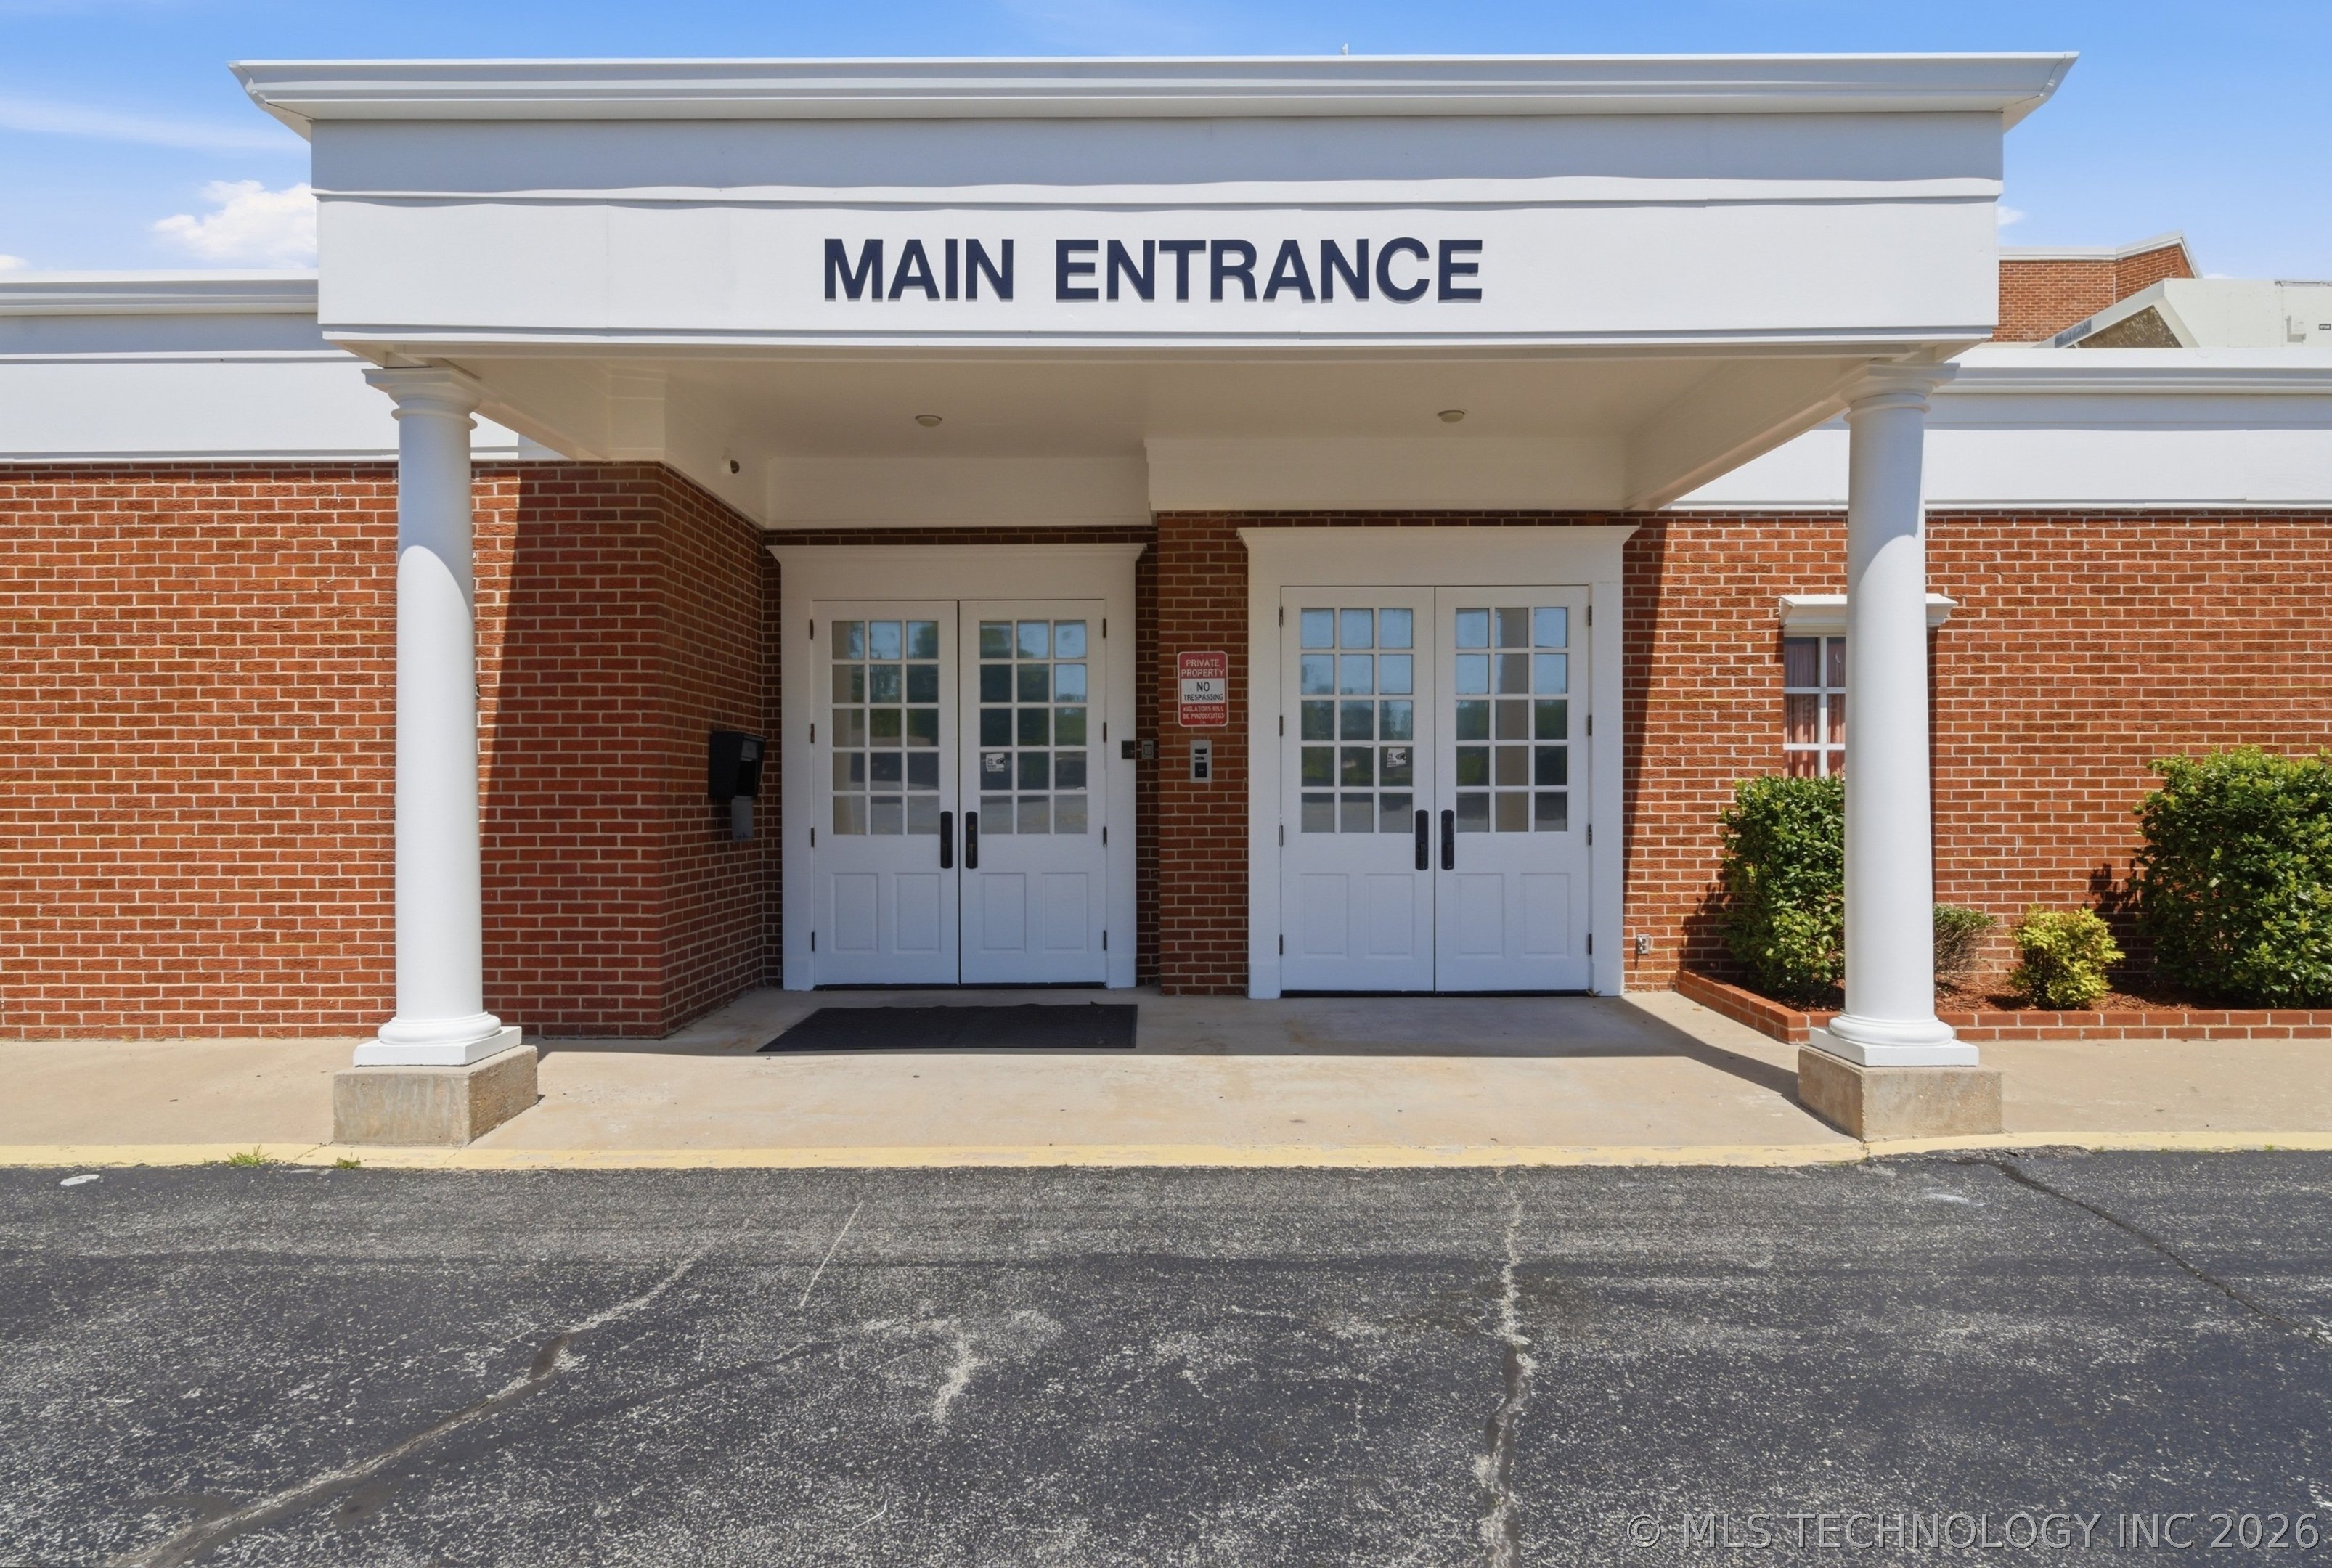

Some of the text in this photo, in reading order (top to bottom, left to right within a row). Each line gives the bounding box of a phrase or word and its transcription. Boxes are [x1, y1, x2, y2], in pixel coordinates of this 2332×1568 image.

[825, 237, 1483, 303] MAIN ENTRANCE
[1196, 682, 1210, 692] NO
